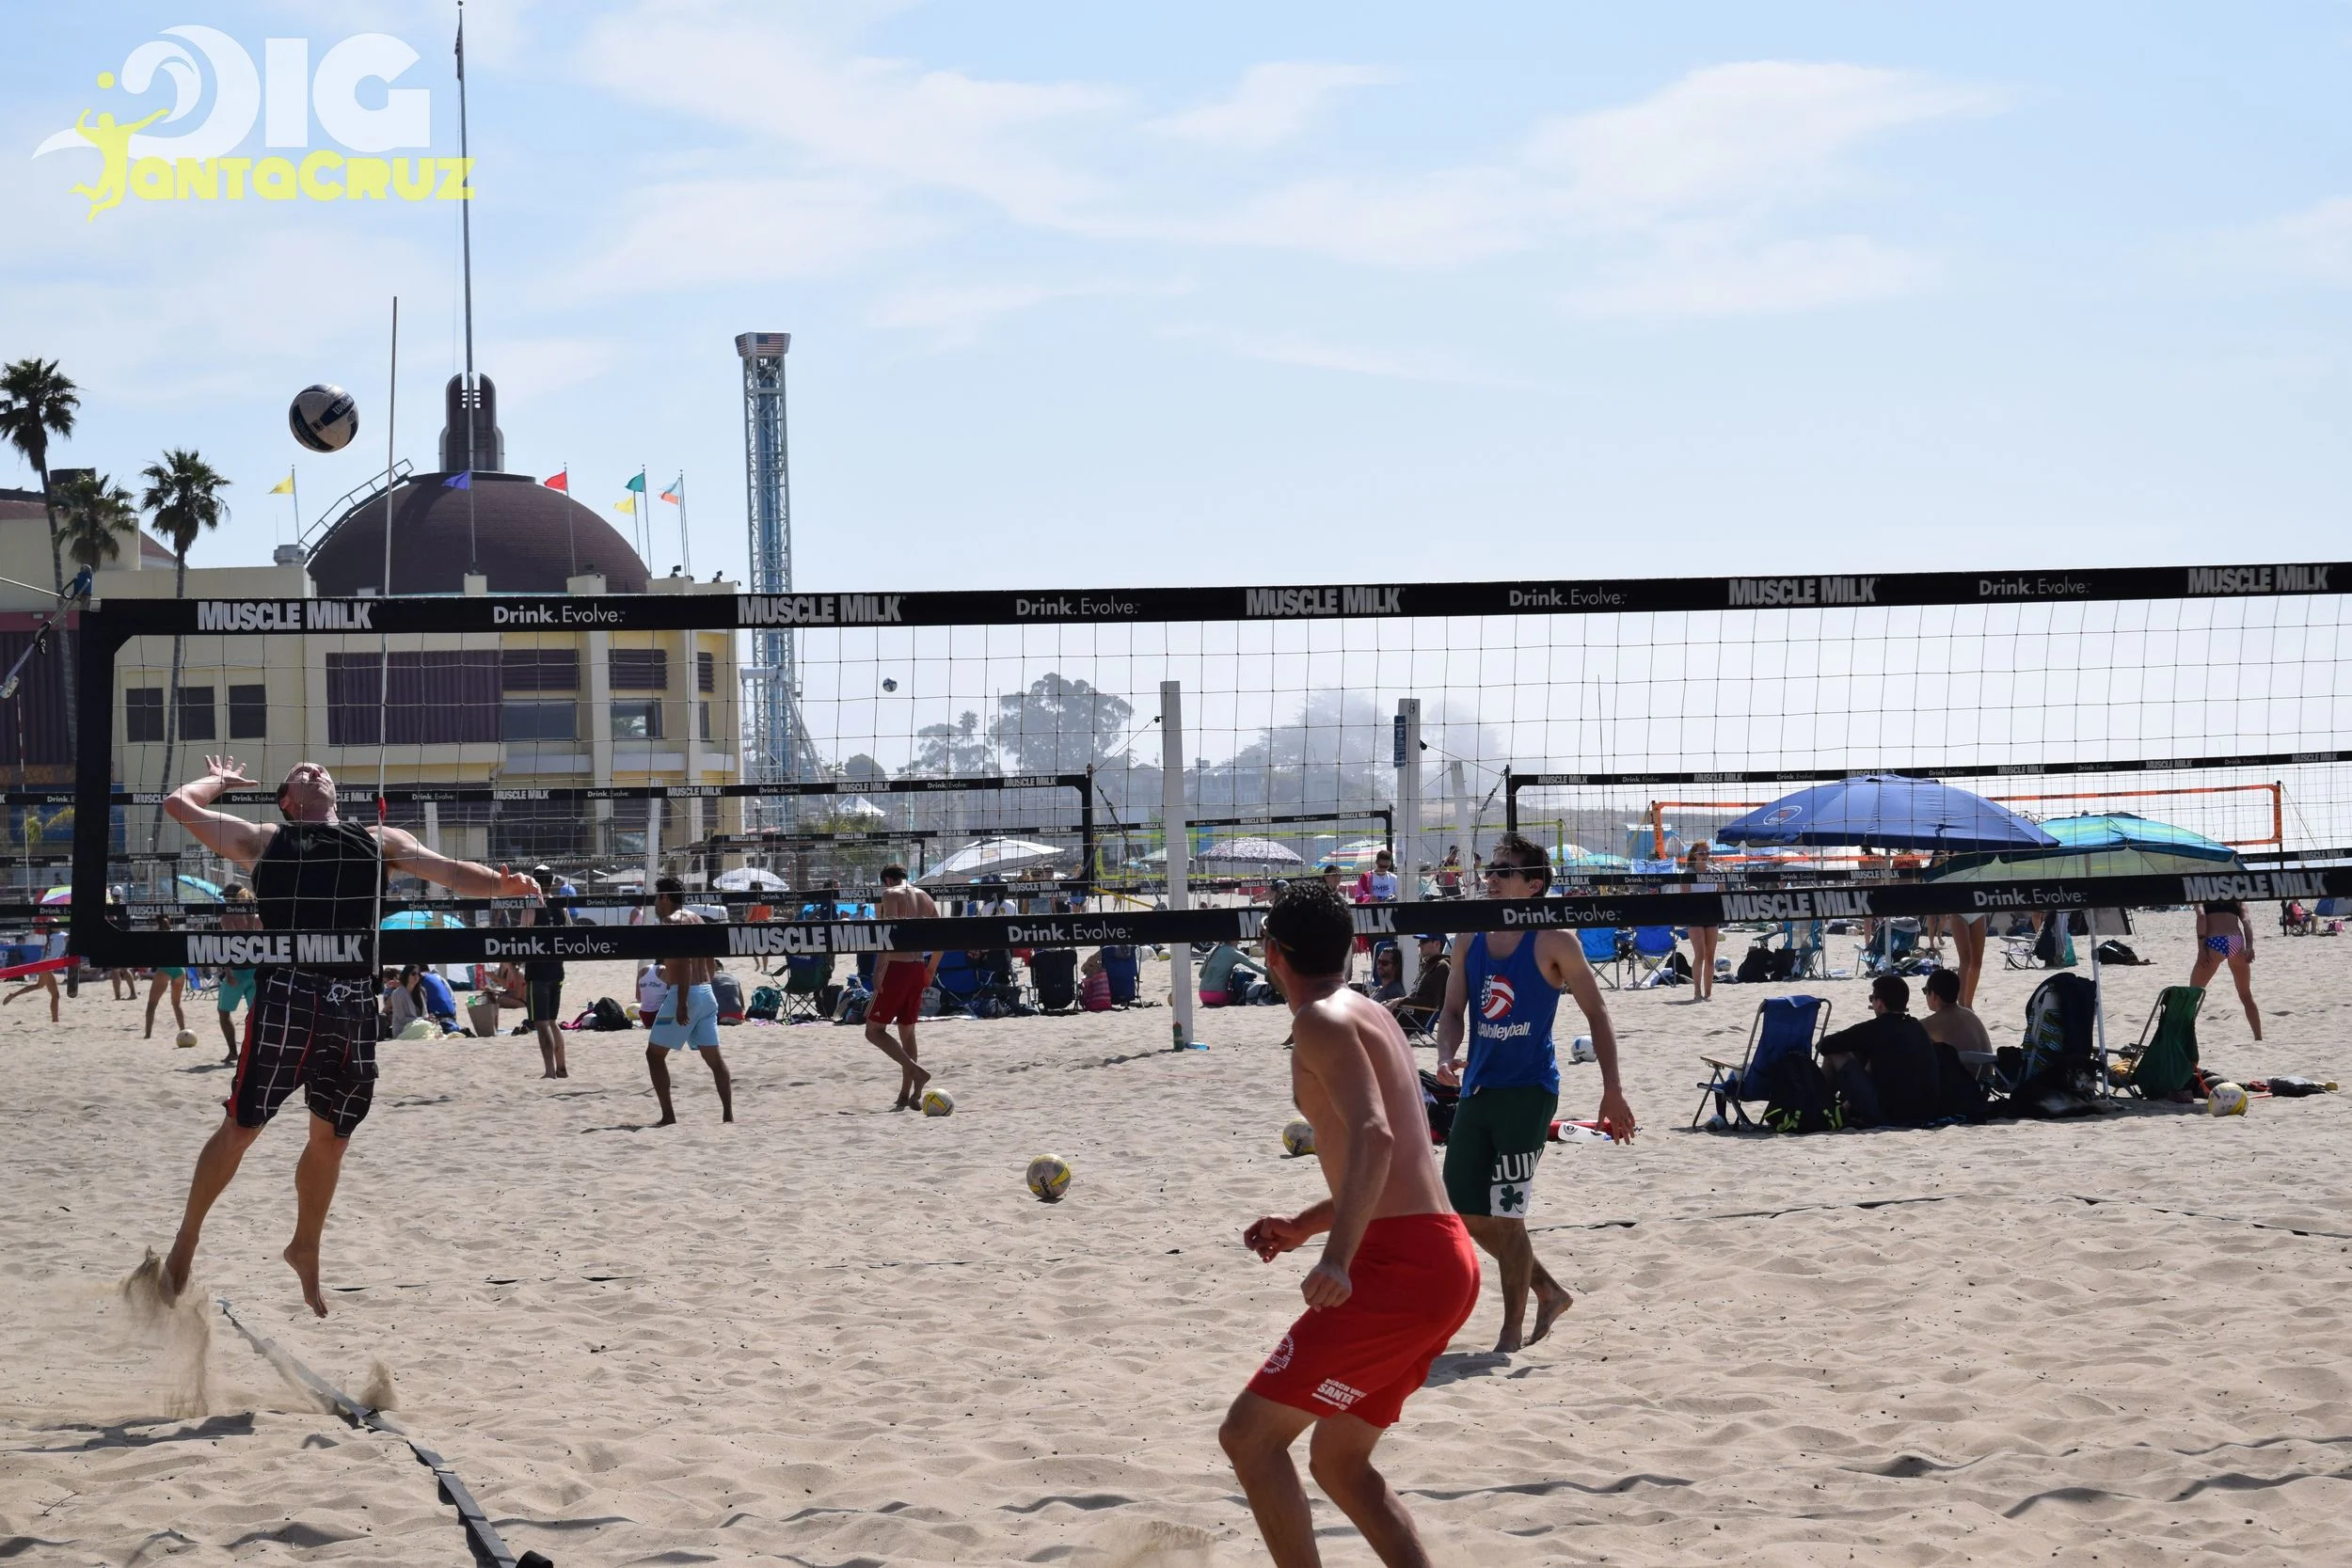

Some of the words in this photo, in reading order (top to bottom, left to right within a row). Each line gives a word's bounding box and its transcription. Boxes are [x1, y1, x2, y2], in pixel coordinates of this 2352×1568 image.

[2187, 567, 2271, 594] MUSCLE
[2276, 565, 2328, 592] MILK
[1728, 578, 1815, 606] MUSCLE
[1820, 577, 1876, 604] MILK
[1246, 588, 1337, 616] MUSCLE
[1343, 587, 1401, 614] MILK
[738, 595, 834, 625] MUSCLE
[840, 594, 902, 623] MILK
[198, 601, 300, 630] MUSCLE
[306, 601, 372, 629] MILK
[2292, 753, 2319, 763] MUSCLE
[2320, 752, 2338, 762] MILK
[2146, 760, 2173, 768] MUSCLE
[2174, 759, 2192, 768] MILK
[1997, 766, 2026, 775] MUSCLE
[2026, 765, 2045, 773] MILK
[1004, 778, 1035, 787] MUSCLE
[1036, 777, 1057, 786] MILK
[1538, 775, 1568, 784] MUSCLE
[1568, 775, 1588, 784] MILK
[1693, 773, 1724, 782] MUSCLE
[1724, 773, 1742, 782] MILK
[667, 786, 700, 797] MUSCLE
[701, 785, 723, 796] MILK
[836, 783, 869, 793] MUSCLE
[870, 782, 891, 791] MILK
[351, 792, 373, 801] MILK
[493, 790, 527, 800] MUSCLE
[528, 790, 549, 800] MILK
[2327, 849, 2345, 859] MILK
[1696, 874, 1726, 883] MUSCLE
[1727, 874, 1746, 882] MILK
[1851, 870, 1880, 879] MUSCLE
[1881, 869, 1899, 879] MLK
[1552, 877, 1569, 886] SCLE
[1570, 876, 1590, 885] MILK
[1008, 882, 1039, 892] MUSCLE
[1039, 881, 1060, 891] MILK
[2182, 875, 2270, 903] MUSCLE
[2273, 872, 2328, 898] MILK
[839, 888, 871, 898] MUSCLE
[701, 894, 723, 904] MILK
[491, 899, 525, 910] MUSCLE
[1722, 891, 1811, 921] MUSCLE
[1815, 889, 1873, 918] MILK
[126, 906, 162, 915] MUSCLE
[164, 905, 185, 914] MILK
[728, 927, 827, 956] MUSCLE
[831, 925, 895, 953] MILK
[187, 936, 291, 964] MUSCLE
[296, 935, 363, 963] MILK
